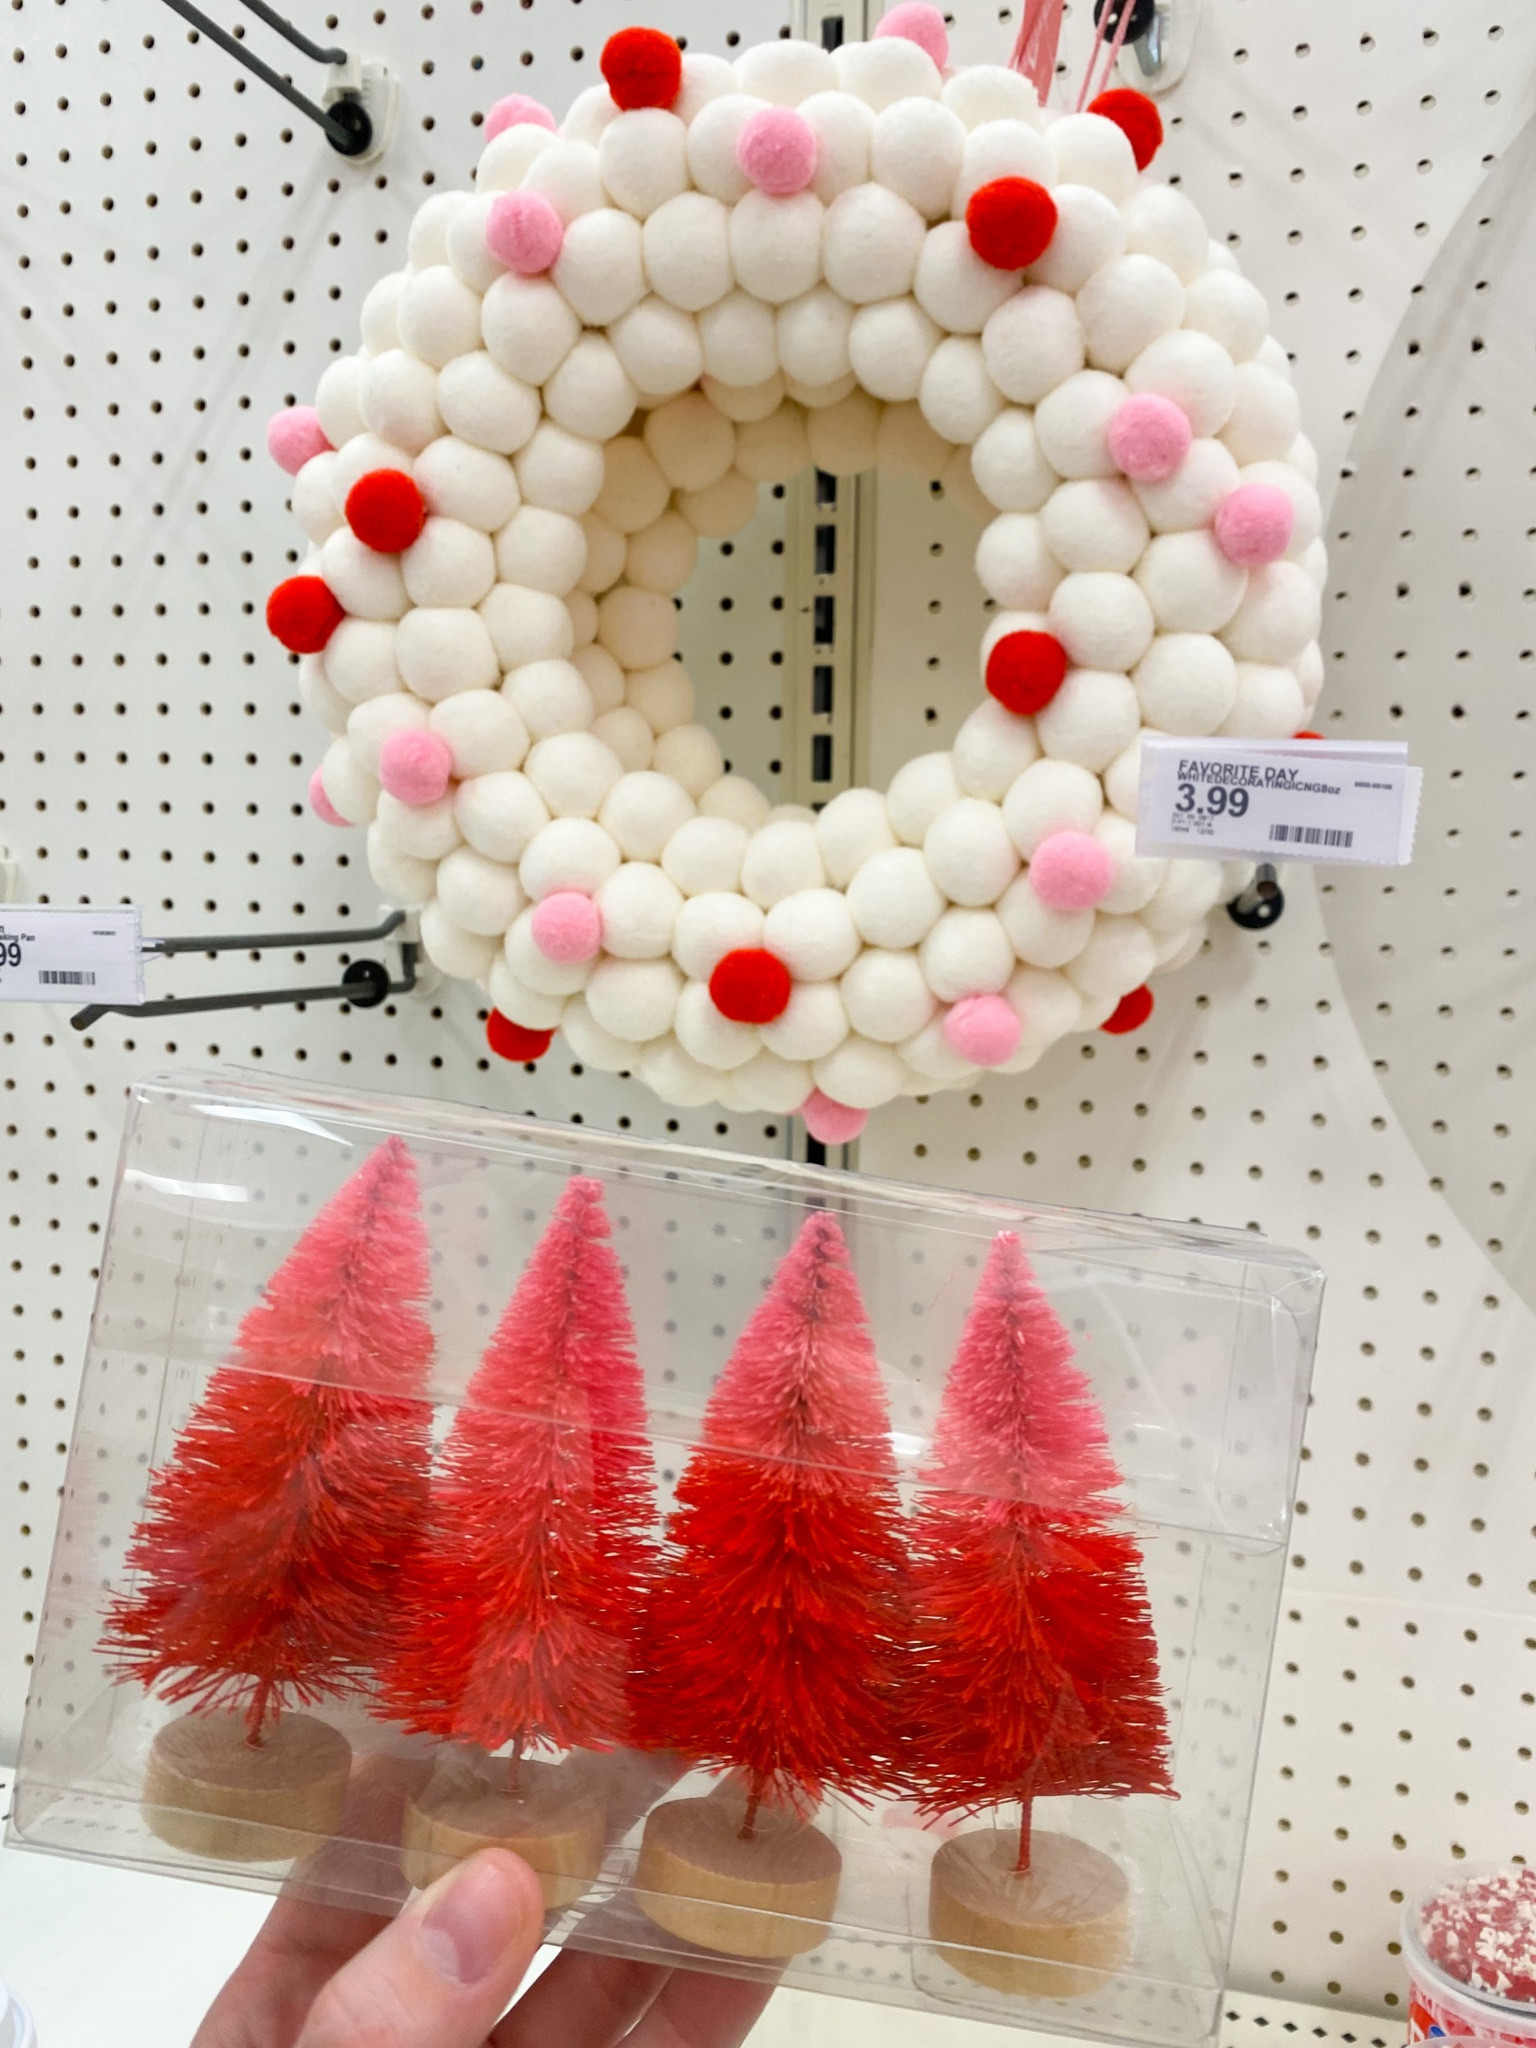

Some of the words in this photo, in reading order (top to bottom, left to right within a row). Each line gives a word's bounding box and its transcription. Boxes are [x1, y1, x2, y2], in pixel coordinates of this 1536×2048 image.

[1178, 759, 1260, 780] FAVORITE
[1264, 767, 1299, 782] DAY
[1175, 783, 1250, 818] 3.99
